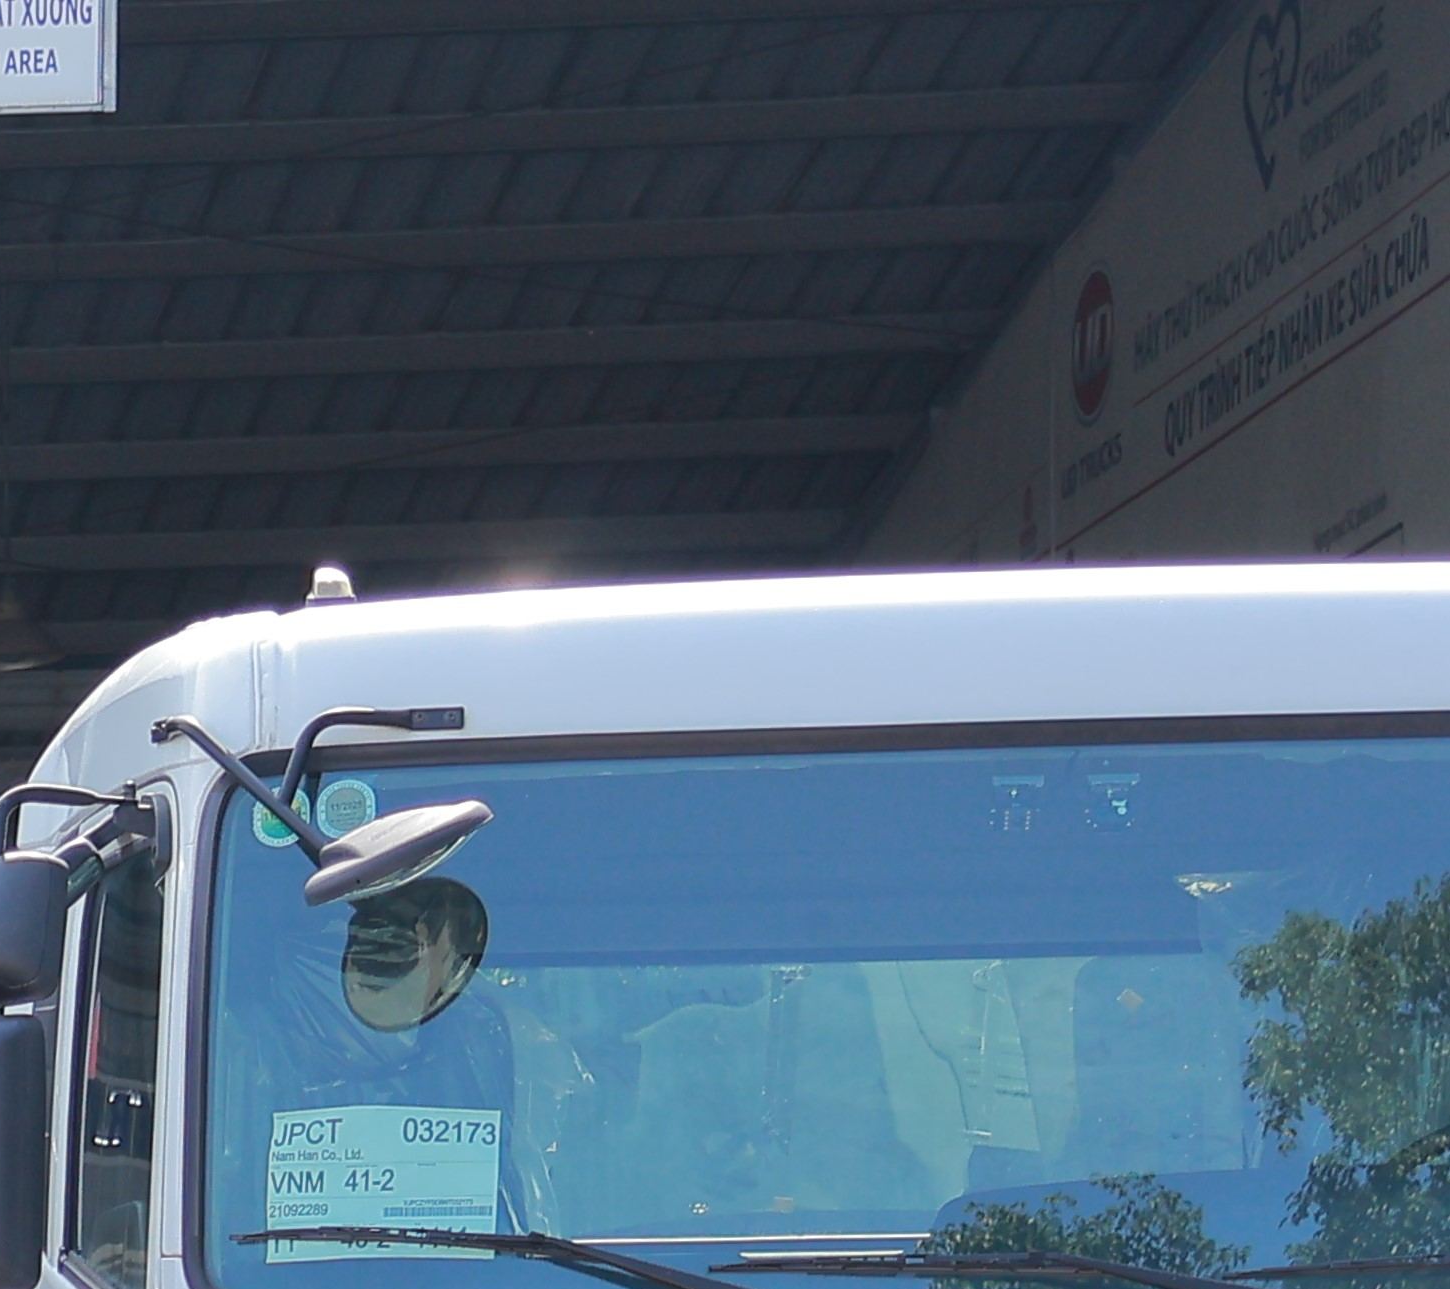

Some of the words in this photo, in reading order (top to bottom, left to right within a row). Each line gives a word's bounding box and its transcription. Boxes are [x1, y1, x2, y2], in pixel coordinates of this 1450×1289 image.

[5, 49, 58, 75] AREA
[1244, 228, 1273, 293] CHO
[1165, 389, 1195, 458] QUY
[1198, 352, 1241, 433] TRÌNH
[1325, 278, 1346, 344] XE
[1349, 244, 1379, 327] SỬA
[1384, 210, 1429, 300] CHỮA
[274, 1118, 343, 1147] JPCT
[403, 1117, 497, 1145] 032173
[271, 1151, 295, 1161] Nam
[299, 1150, 319, 1161] Han
[321, 1150, 342, 1162] Co.,
[345, 1149, 365, 1161] Ltd.
[270, 1170, 325, 1194] VNM
[344, 1168, 395, 1193] 41-2
[269, 1203, 329, 1218] 21092289
